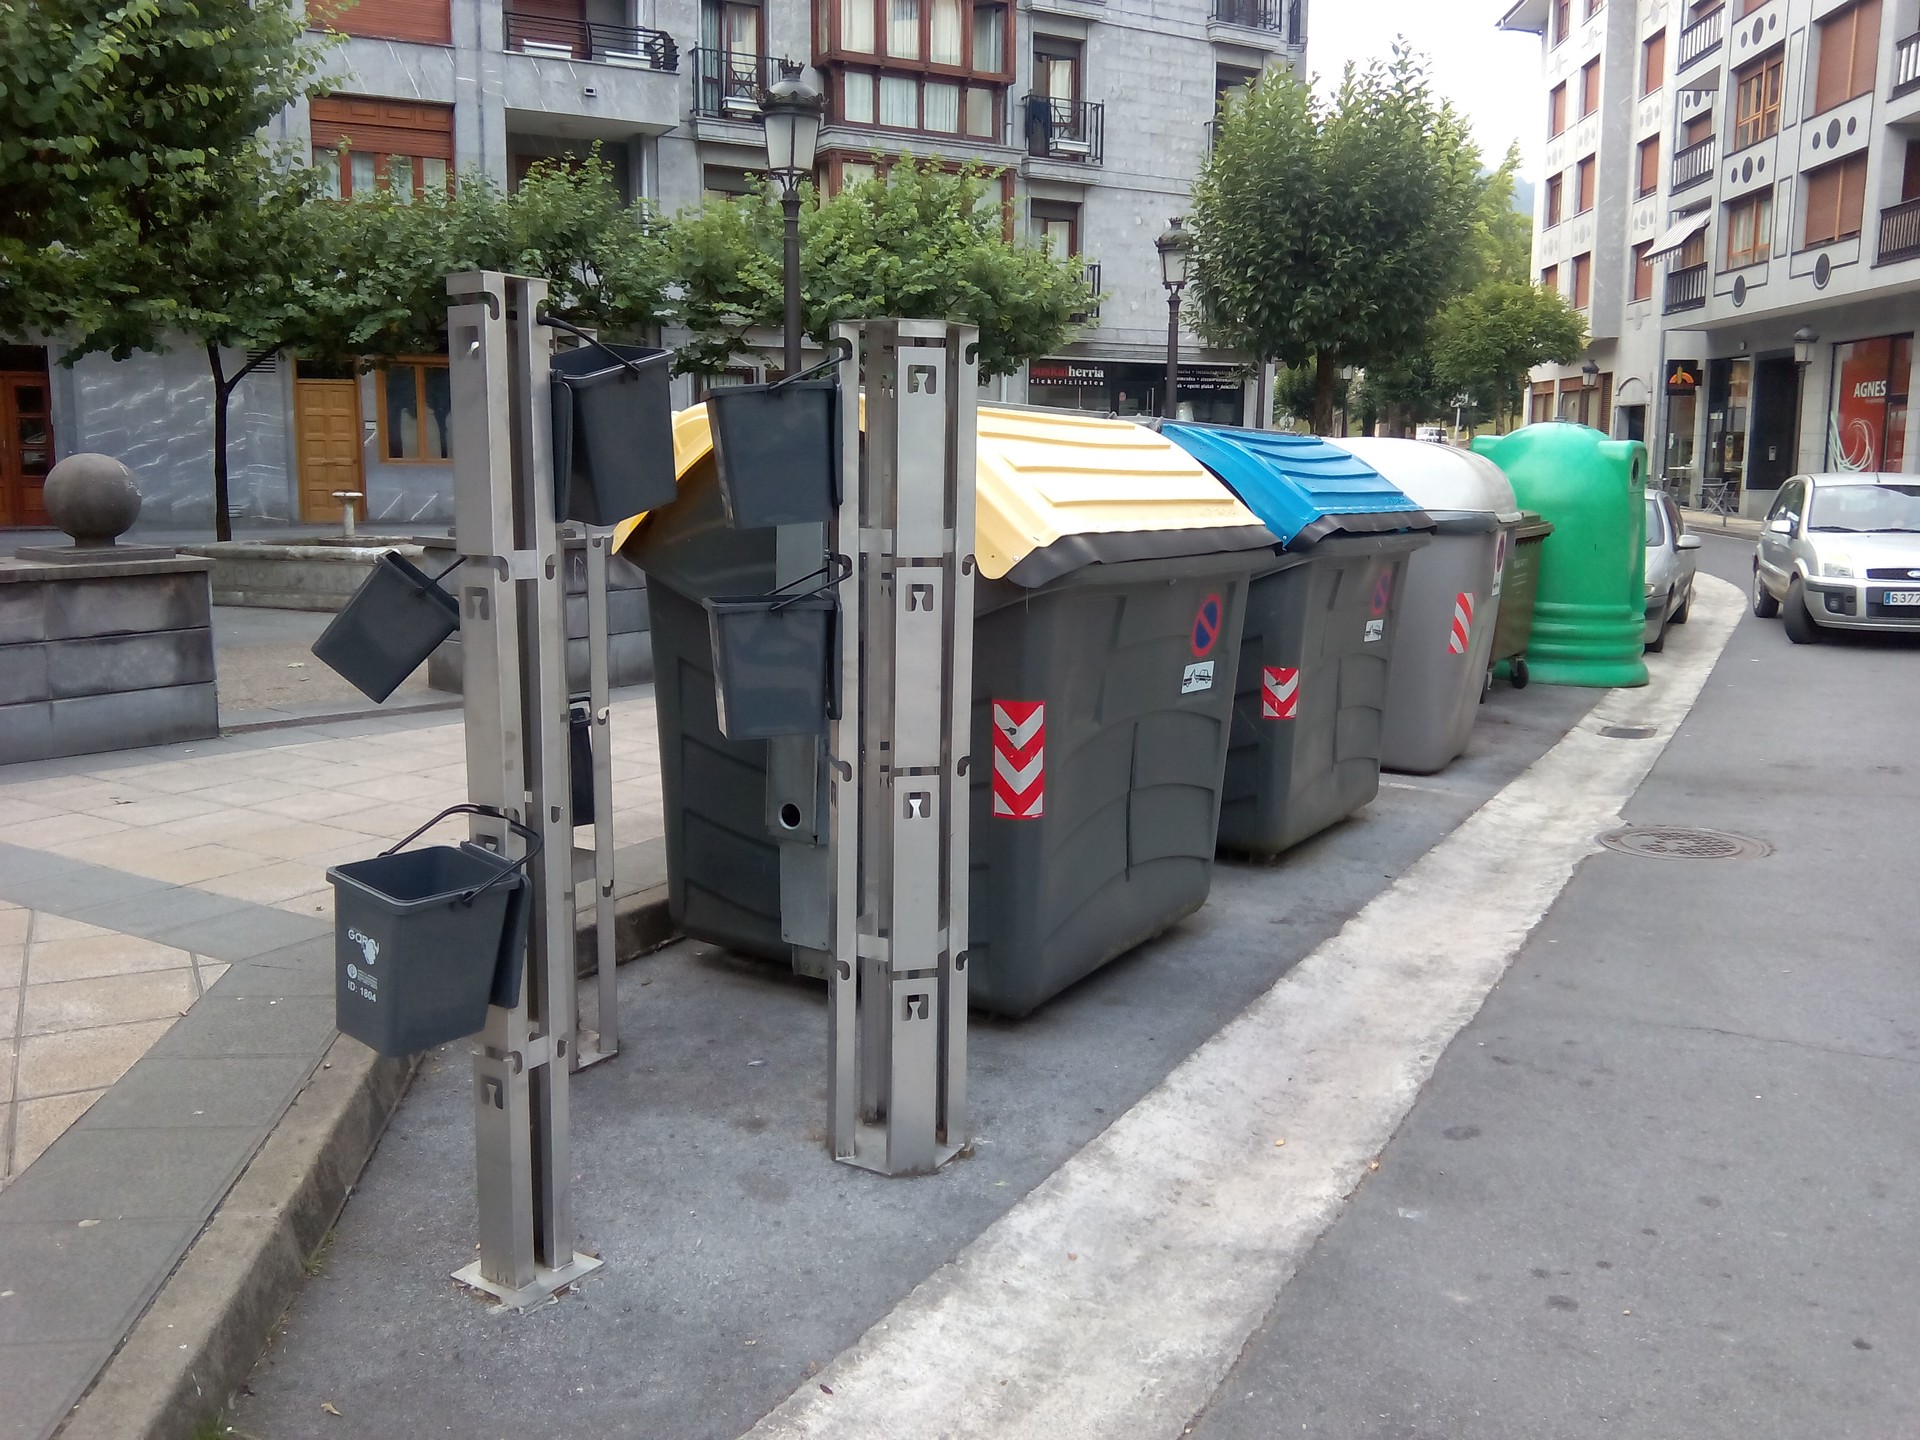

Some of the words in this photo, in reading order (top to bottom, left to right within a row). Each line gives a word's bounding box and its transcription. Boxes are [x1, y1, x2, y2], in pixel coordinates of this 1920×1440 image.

[1853, 380, 1886, 398] AGNES
[347, 980, 358, 992] ID:
[360, 986, 377, 1003] 1804
